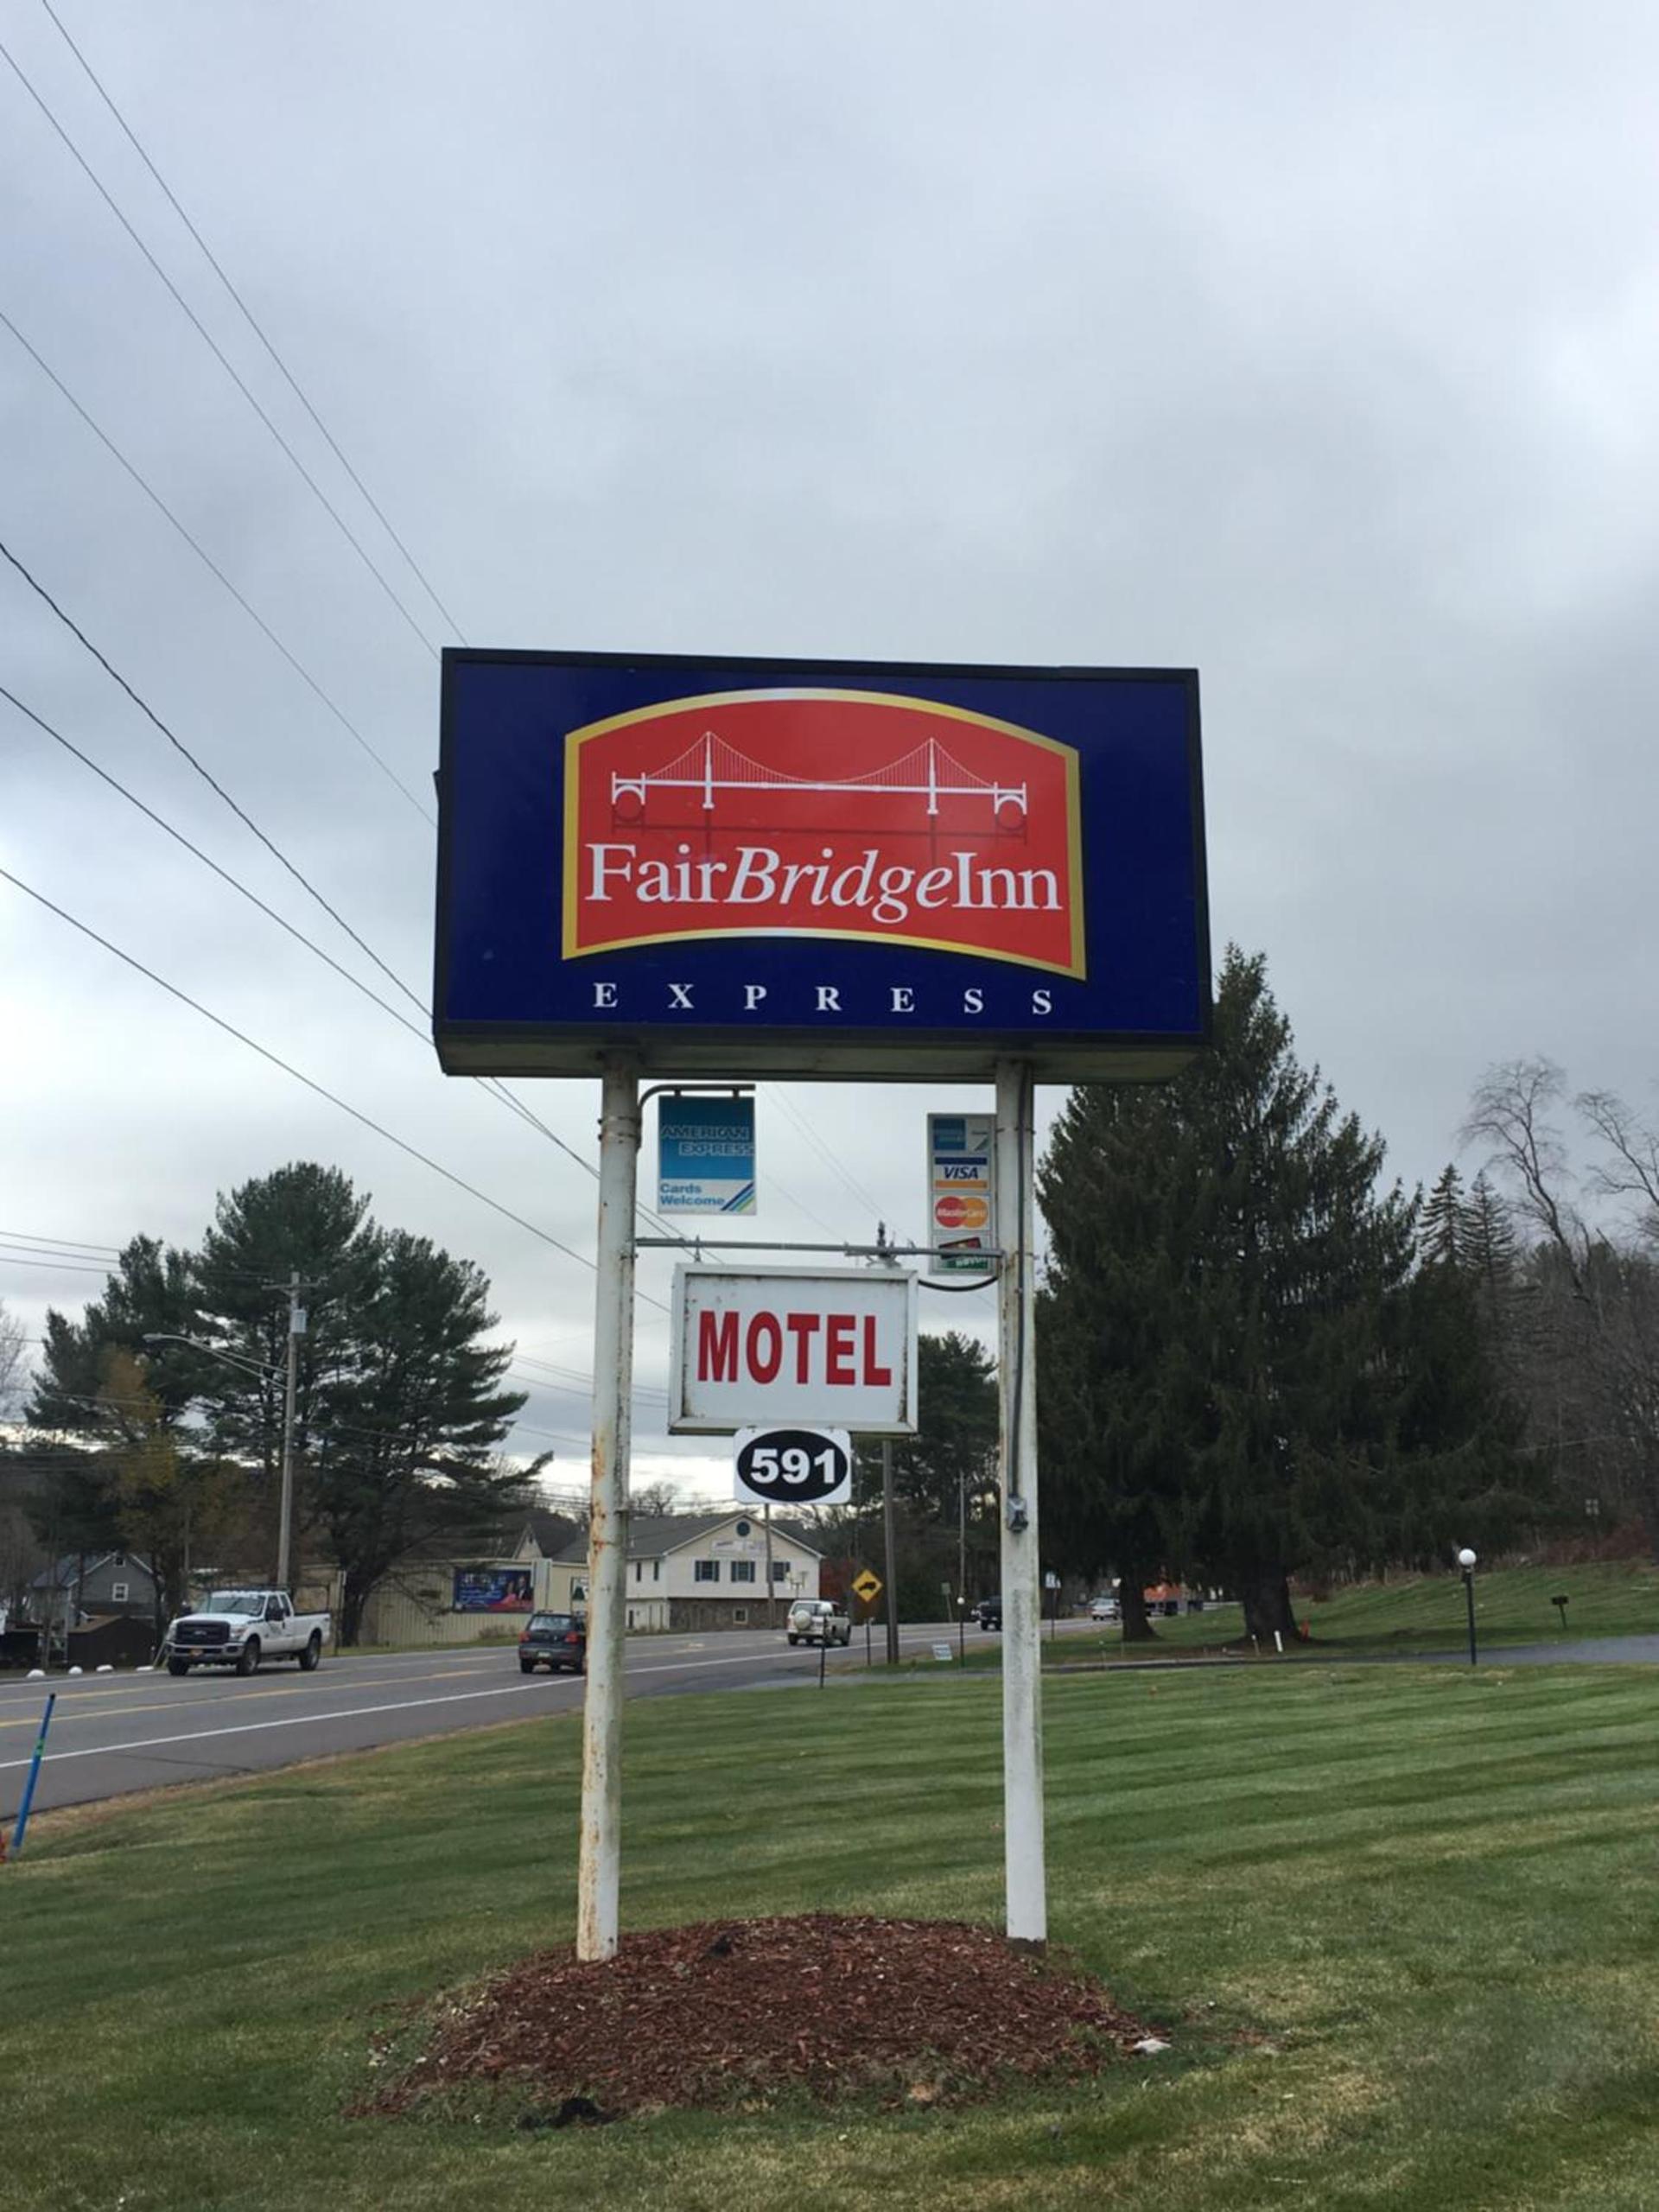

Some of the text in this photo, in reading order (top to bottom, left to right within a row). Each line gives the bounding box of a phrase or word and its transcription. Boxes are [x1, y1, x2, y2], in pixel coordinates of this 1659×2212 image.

[593, 982, 1052, 1014] EXPRESS
[660, 1125, 750, 1140] AMERICAN
[678, 1141, 754, 1156] EXPRESS
[944, 1166, 978, 1179] VISA
[660, 1183, 702, 1193] Cards
[660, 1195, 725, 1205] Welcome
[697, 1310, 892, 1386] MOTEL
[750, 1448, 835, 1484] 591
